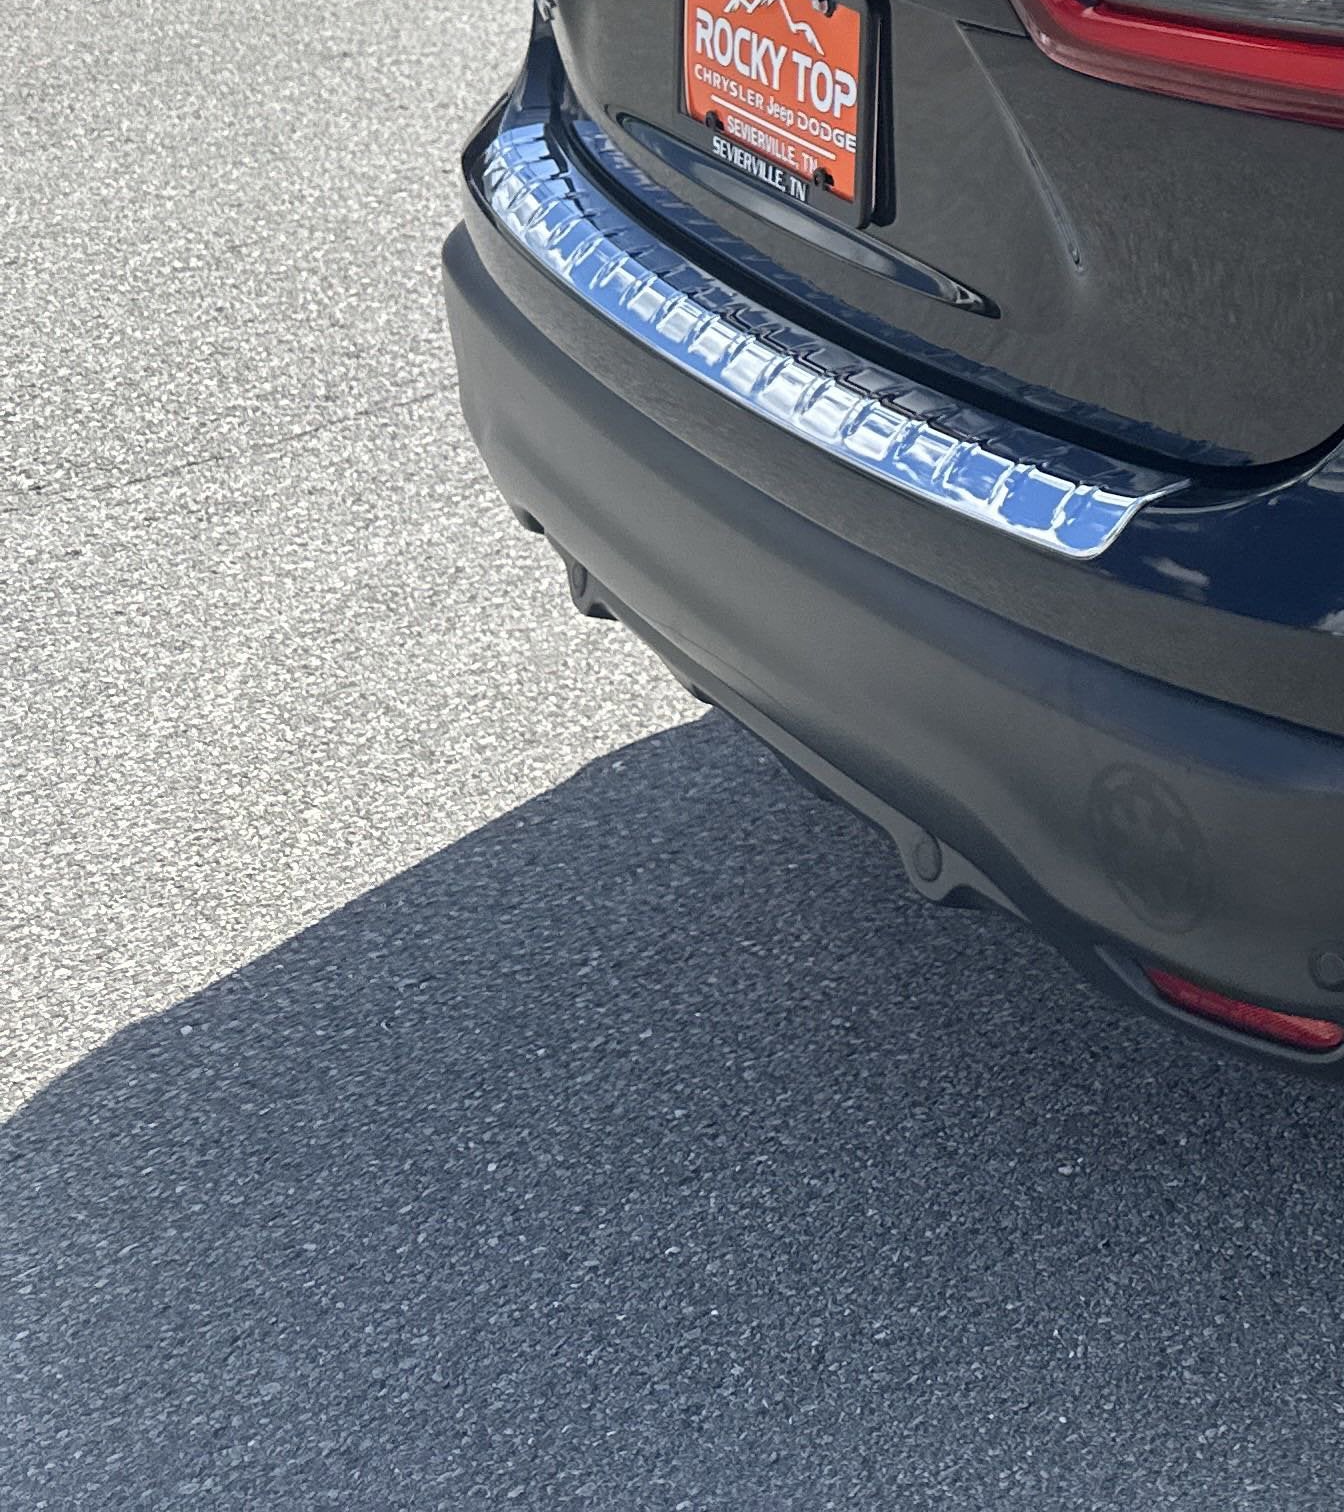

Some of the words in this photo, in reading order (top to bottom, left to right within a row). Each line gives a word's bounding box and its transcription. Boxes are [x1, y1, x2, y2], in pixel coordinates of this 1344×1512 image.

[695, 7, 788, 91] ROCKY
[791, 50, 858, 119] TOP
[694, 63, 764, 110] CHRYSLER
[766, 96, 795, 127] Jeep
[797, 111, 857, 154] DODGE
[726, 115, 799, 169] SEVIERVILLE,
[801, 152, 819, 175] TN
[712, 135, 786, 193] SEVIERVILLE,
[789, 176, 807, 202] TN
